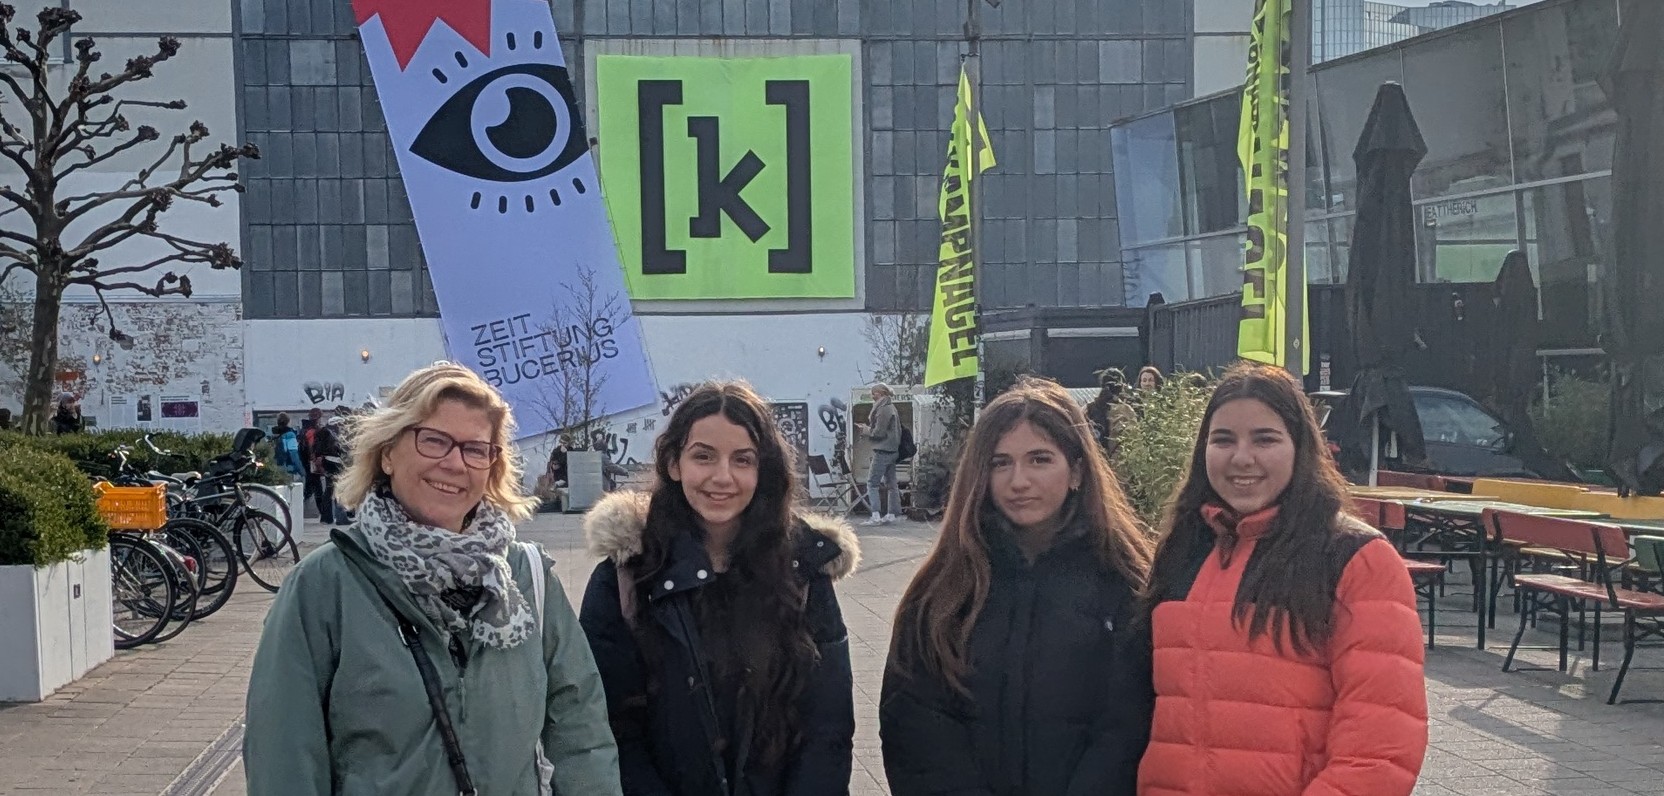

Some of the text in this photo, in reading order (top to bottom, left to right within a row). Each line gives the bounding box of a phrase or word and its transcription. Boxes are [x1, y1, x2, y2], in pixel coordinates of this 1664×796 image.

[470, 313, 531, 347] ZEIT
[476, 317, 614, 368] STIFTUNG
[483, 338, 619, 388] BUCERIUS
